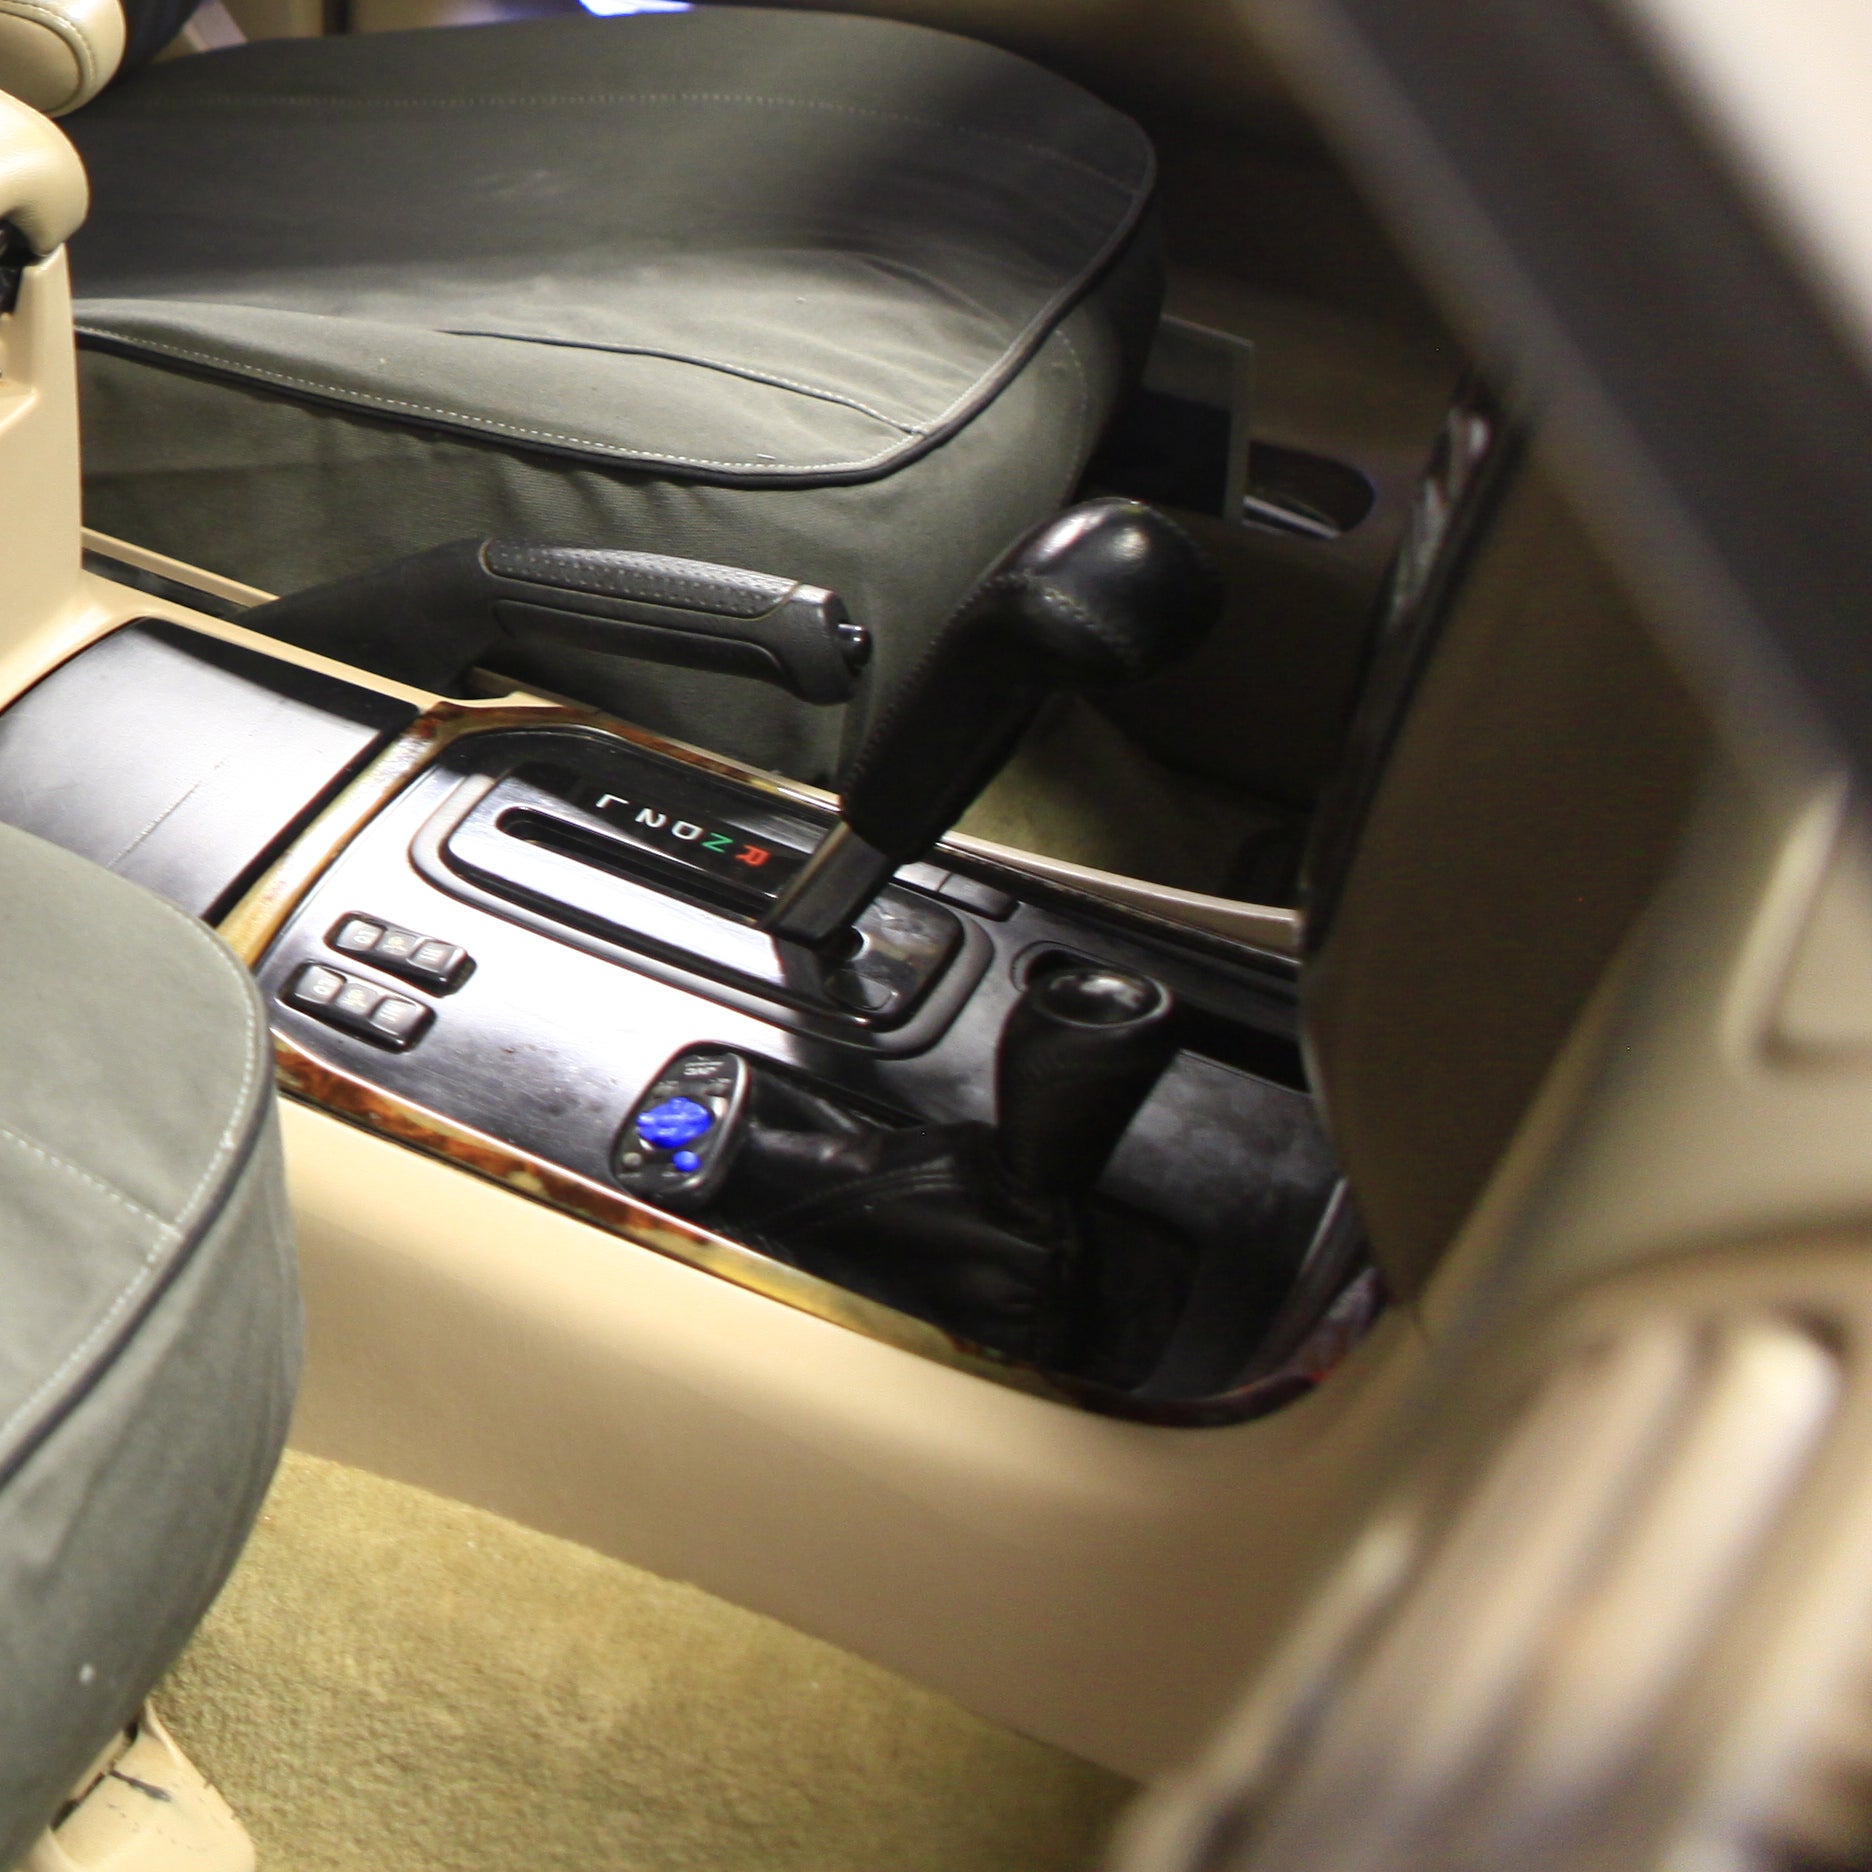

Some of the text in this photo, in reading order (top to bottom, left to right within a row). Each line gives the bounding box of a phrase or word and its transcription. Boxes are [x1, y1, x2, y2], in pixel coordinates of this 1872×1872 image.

[596, 794, 628, 807] L
[635, 808, 667, 828] 2
[671, 820, 705, 840] D
[702, 832, 733, 853] N
[734, 845, 771, 867] R
